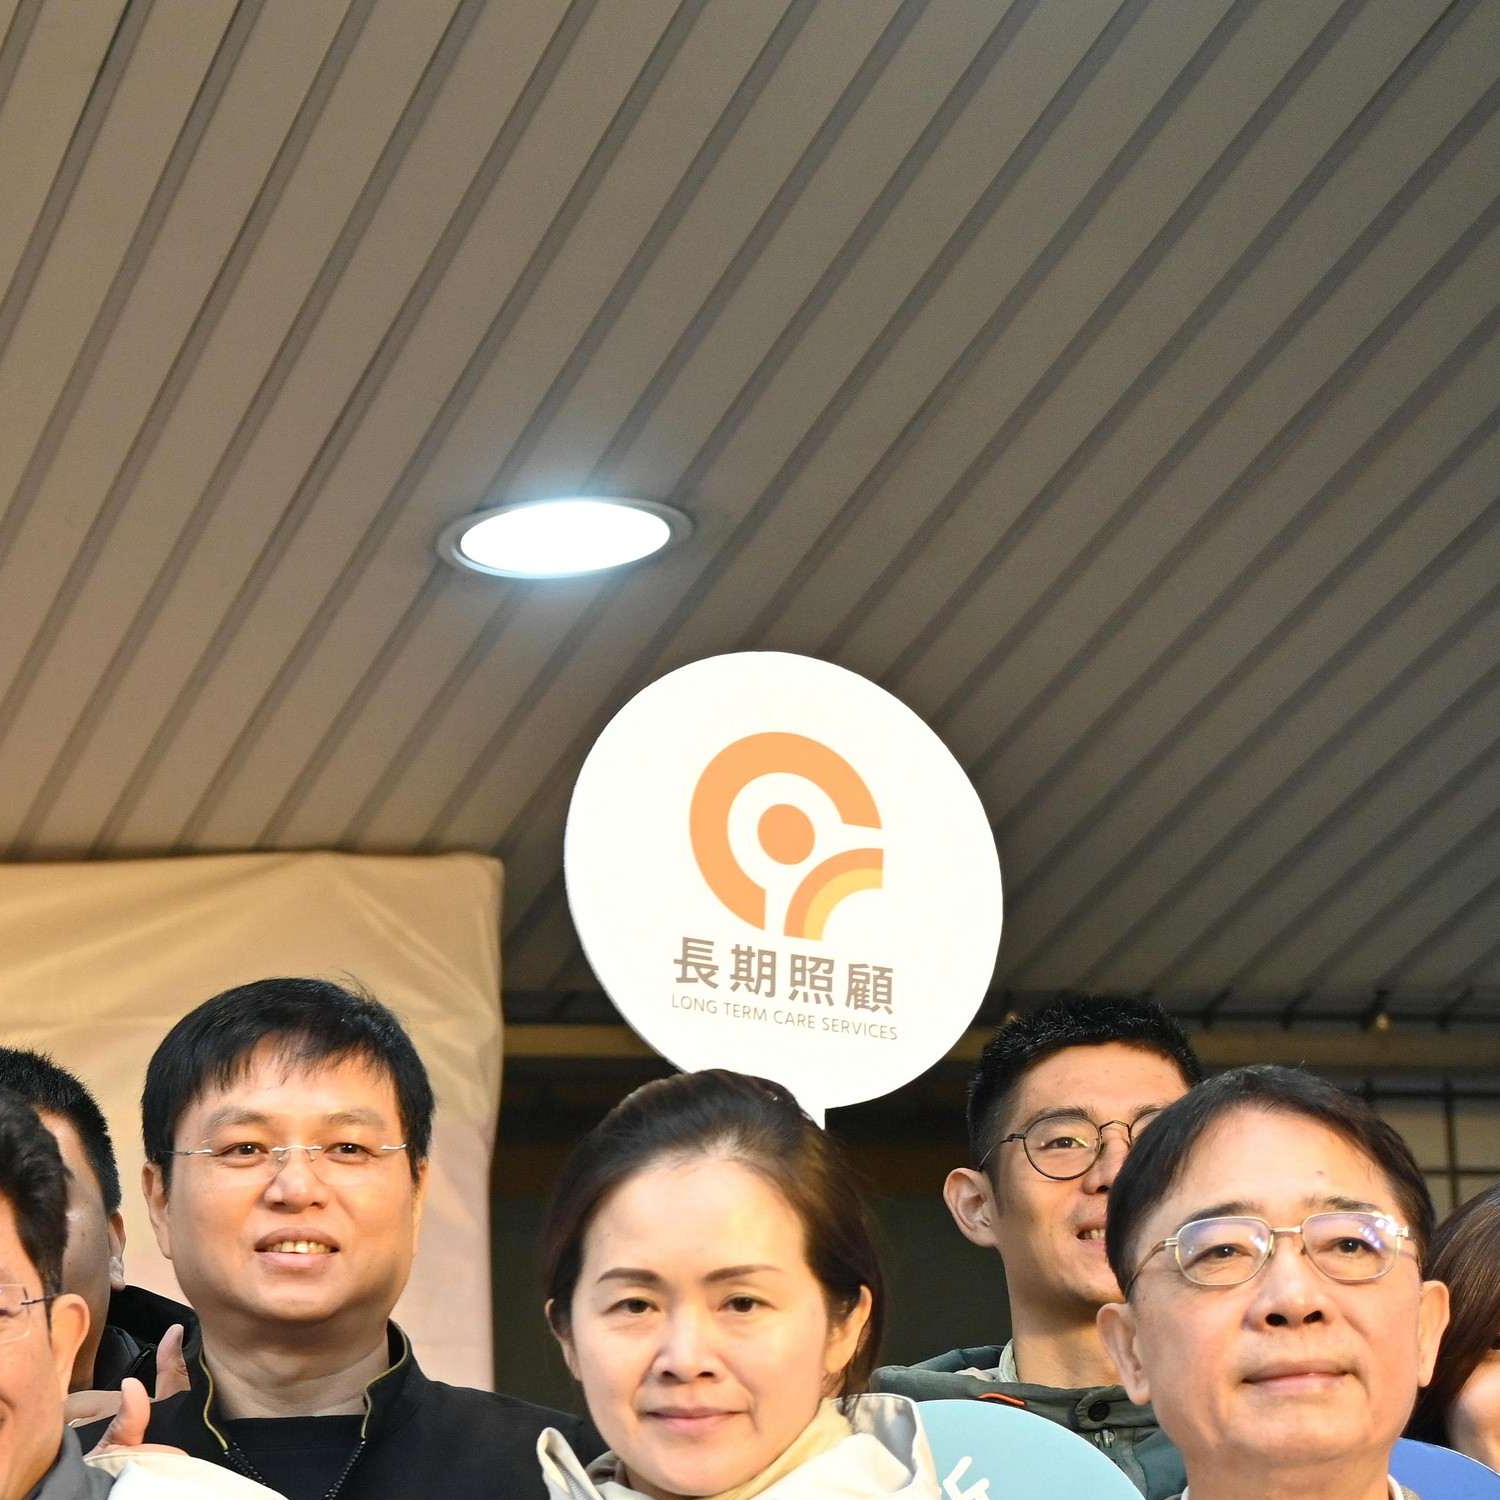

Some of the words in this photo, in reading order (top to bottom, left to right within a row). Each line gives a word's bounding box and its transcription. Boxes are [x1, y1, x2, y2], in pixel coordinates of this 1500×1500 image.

[672, 936, 895, 1016] 長期照顧
[671, 992, 718, 1014] LONG
[723, 1001, 768, 1022] TERM
[772, 1009, 816, 1030] CARE
[821, 1016, 899, 1041] SERVICES
